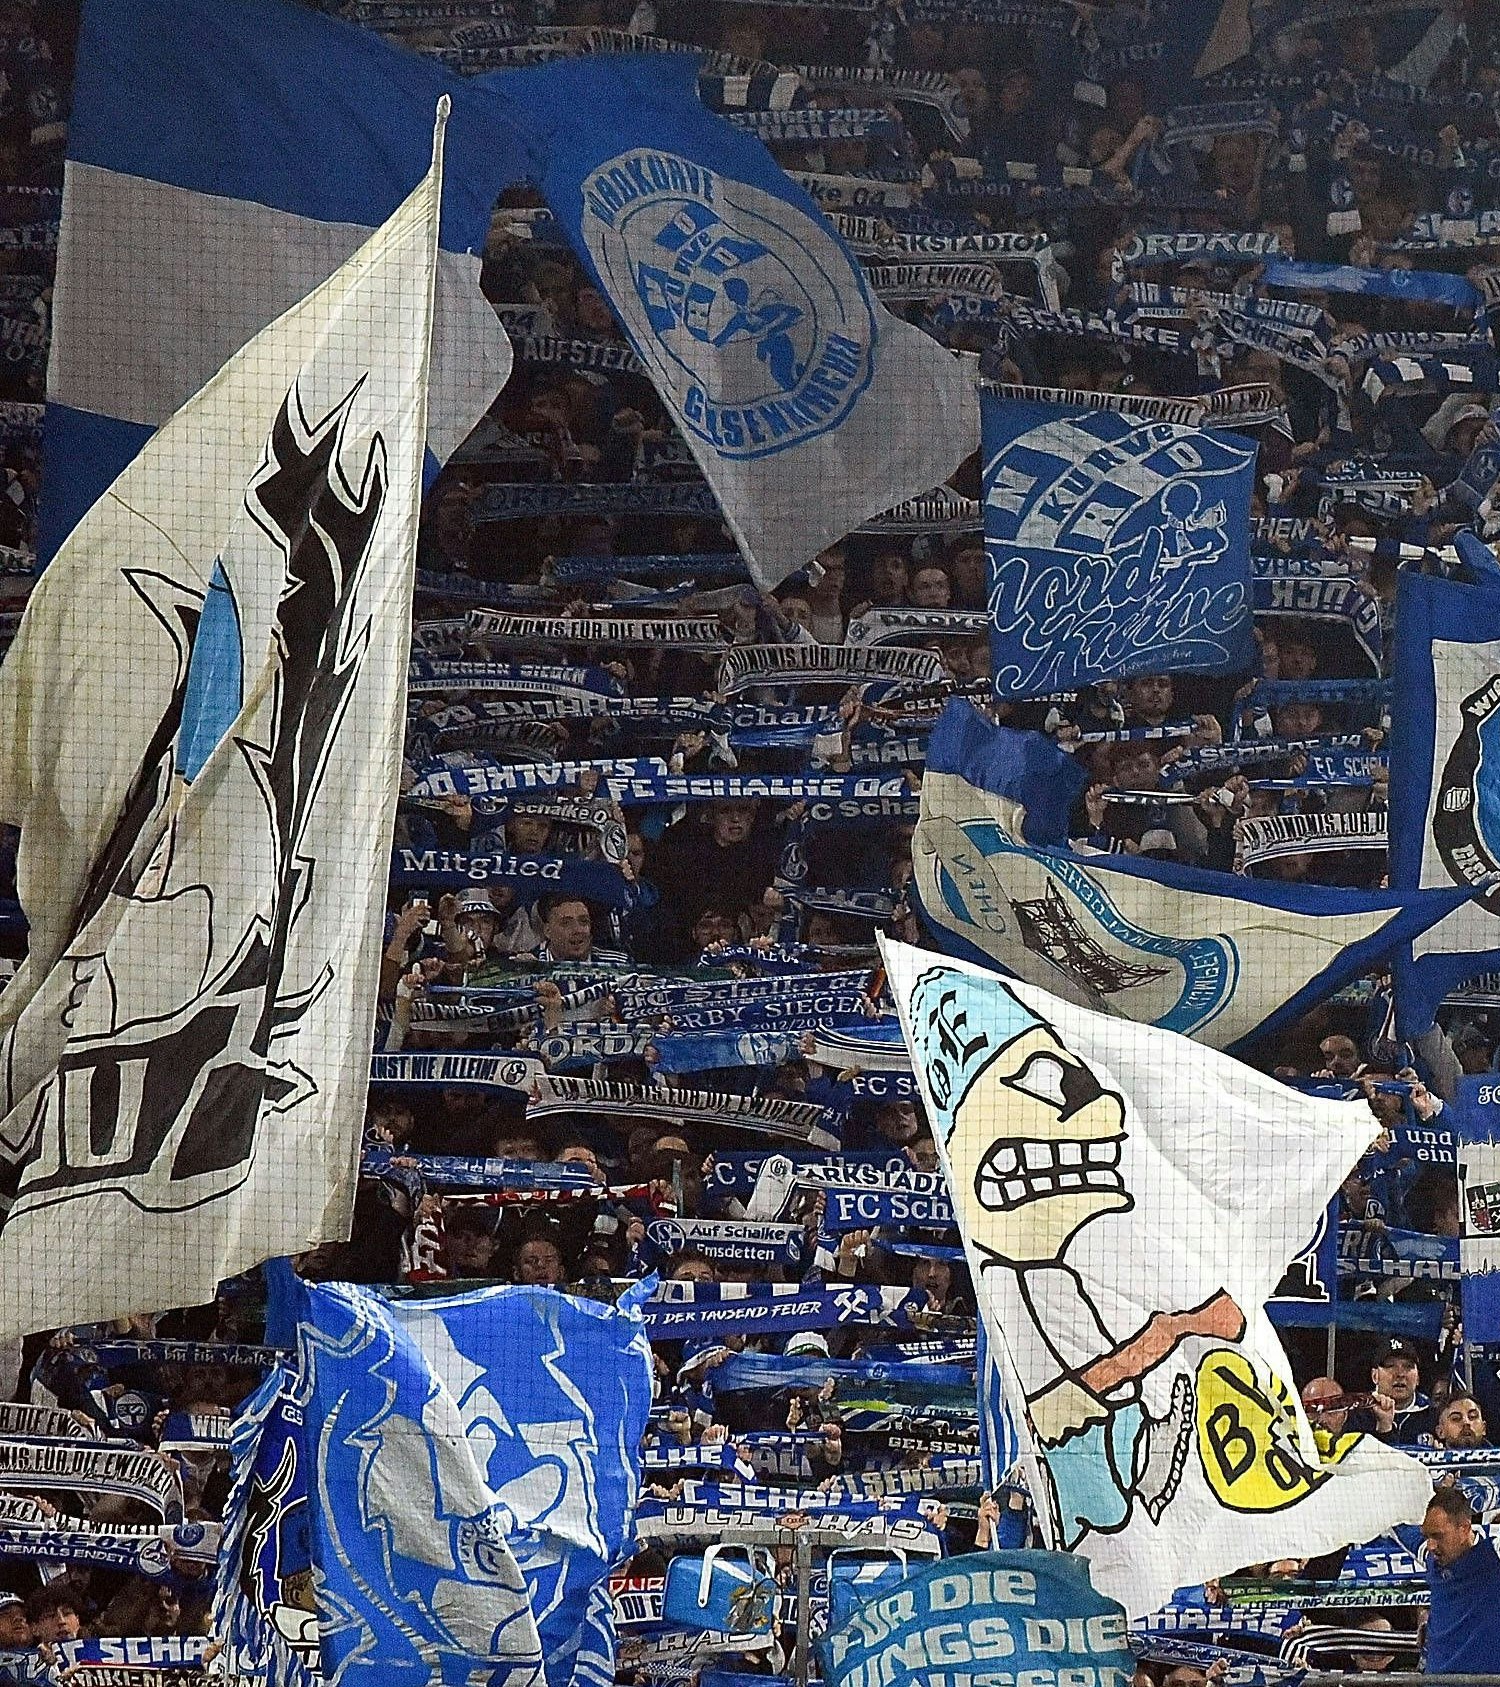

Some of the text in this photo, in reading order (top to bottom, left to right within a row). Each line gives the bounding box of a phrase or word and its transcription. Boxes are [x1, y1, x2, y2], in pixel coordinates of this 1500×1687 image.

[1008, 305, 1181, 348] SCHALKE
[1089, 393, 1116, 412] DIE
[1117, 396, 1196, 423] EWIGKEIT
[573, 619, 636, 641] FÜR DIE
[728, 643, 941, 678] BÜNDNIS FÜR DIE EWIGKEIT
[606, 776, 904, 800] FC SCHALKE 04
[513, 800, 589, 821] Schalke
[1338, 811, 1372, 833] FÜR
[400, 847, 563, 880] Mitglied
[750, 1016, 835, 1033] 2012/2013
[411, 1054, 497, 1082] NIE ALLEIN!
[851, 1076, 888, 1097] FC
[1407, 1129, 1453, 1146] und
[1418, 1145, 1454, 1163] ein
[837, 1194, 883, 1221] FC
[689, 1224, 787, 1242] Auf Schalke
[662, 1301, 823, 1325] DER TAUSEND FEUER
[136, 1343, 158, 1363] Ich
[165, 1344, 188, 1363] bin
[16, 1406, 44, 1429] DIE
[35, 1449, 175, 1495] FÜR DIE EWIGKEIT
[74, 1547, 135, 1567] ENDET!
[621, 1594, 647, 1619] DU
[1326, 1596, 1375, 1607] LEIDEN
[1376, 1596, 1395, 1606] IM
[829, 1567, 1037, 1660] FÜR DIE
[1026, 1614, 1128, 1655] DIE
